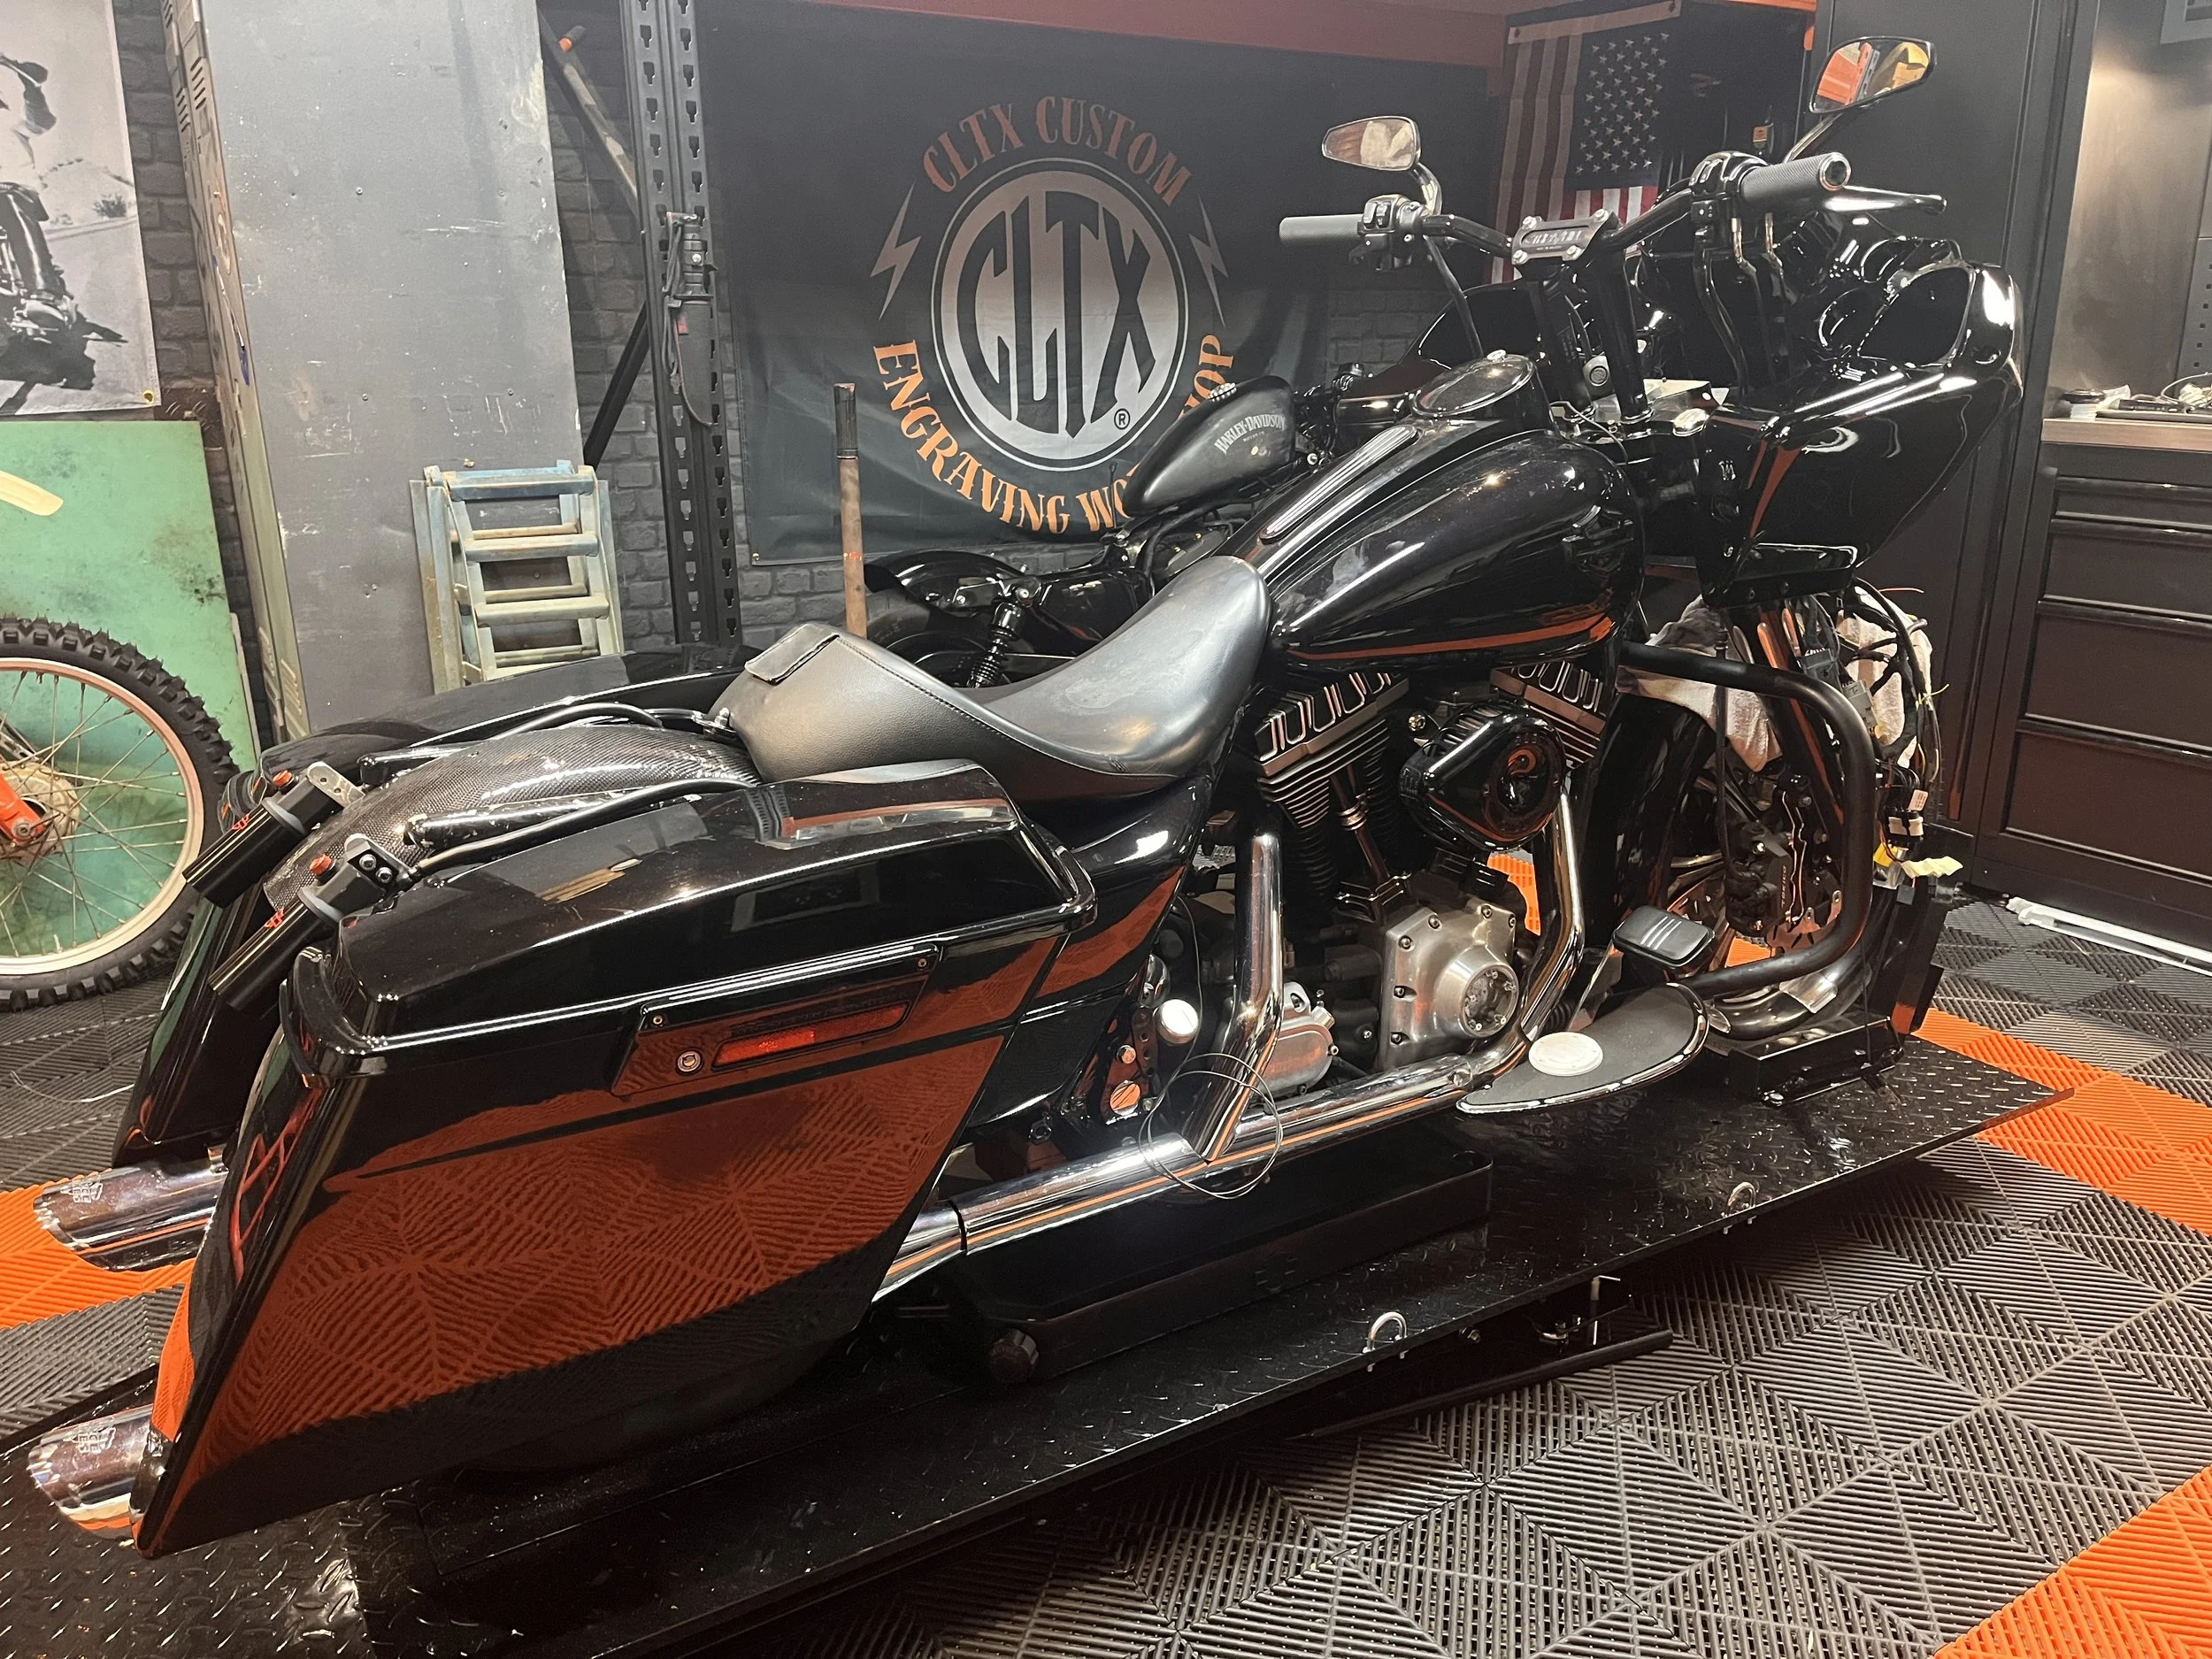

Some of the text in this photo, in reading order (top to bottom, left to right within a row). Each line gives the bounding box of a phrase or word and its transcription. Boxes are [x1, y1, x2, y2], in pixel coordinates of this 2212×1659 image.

[923, 96, 1192, 205] CLTX CUSTOM
[956, 191, 1156, 439] CLTX
[873, 340, 1070, 534] ENGRAVING
